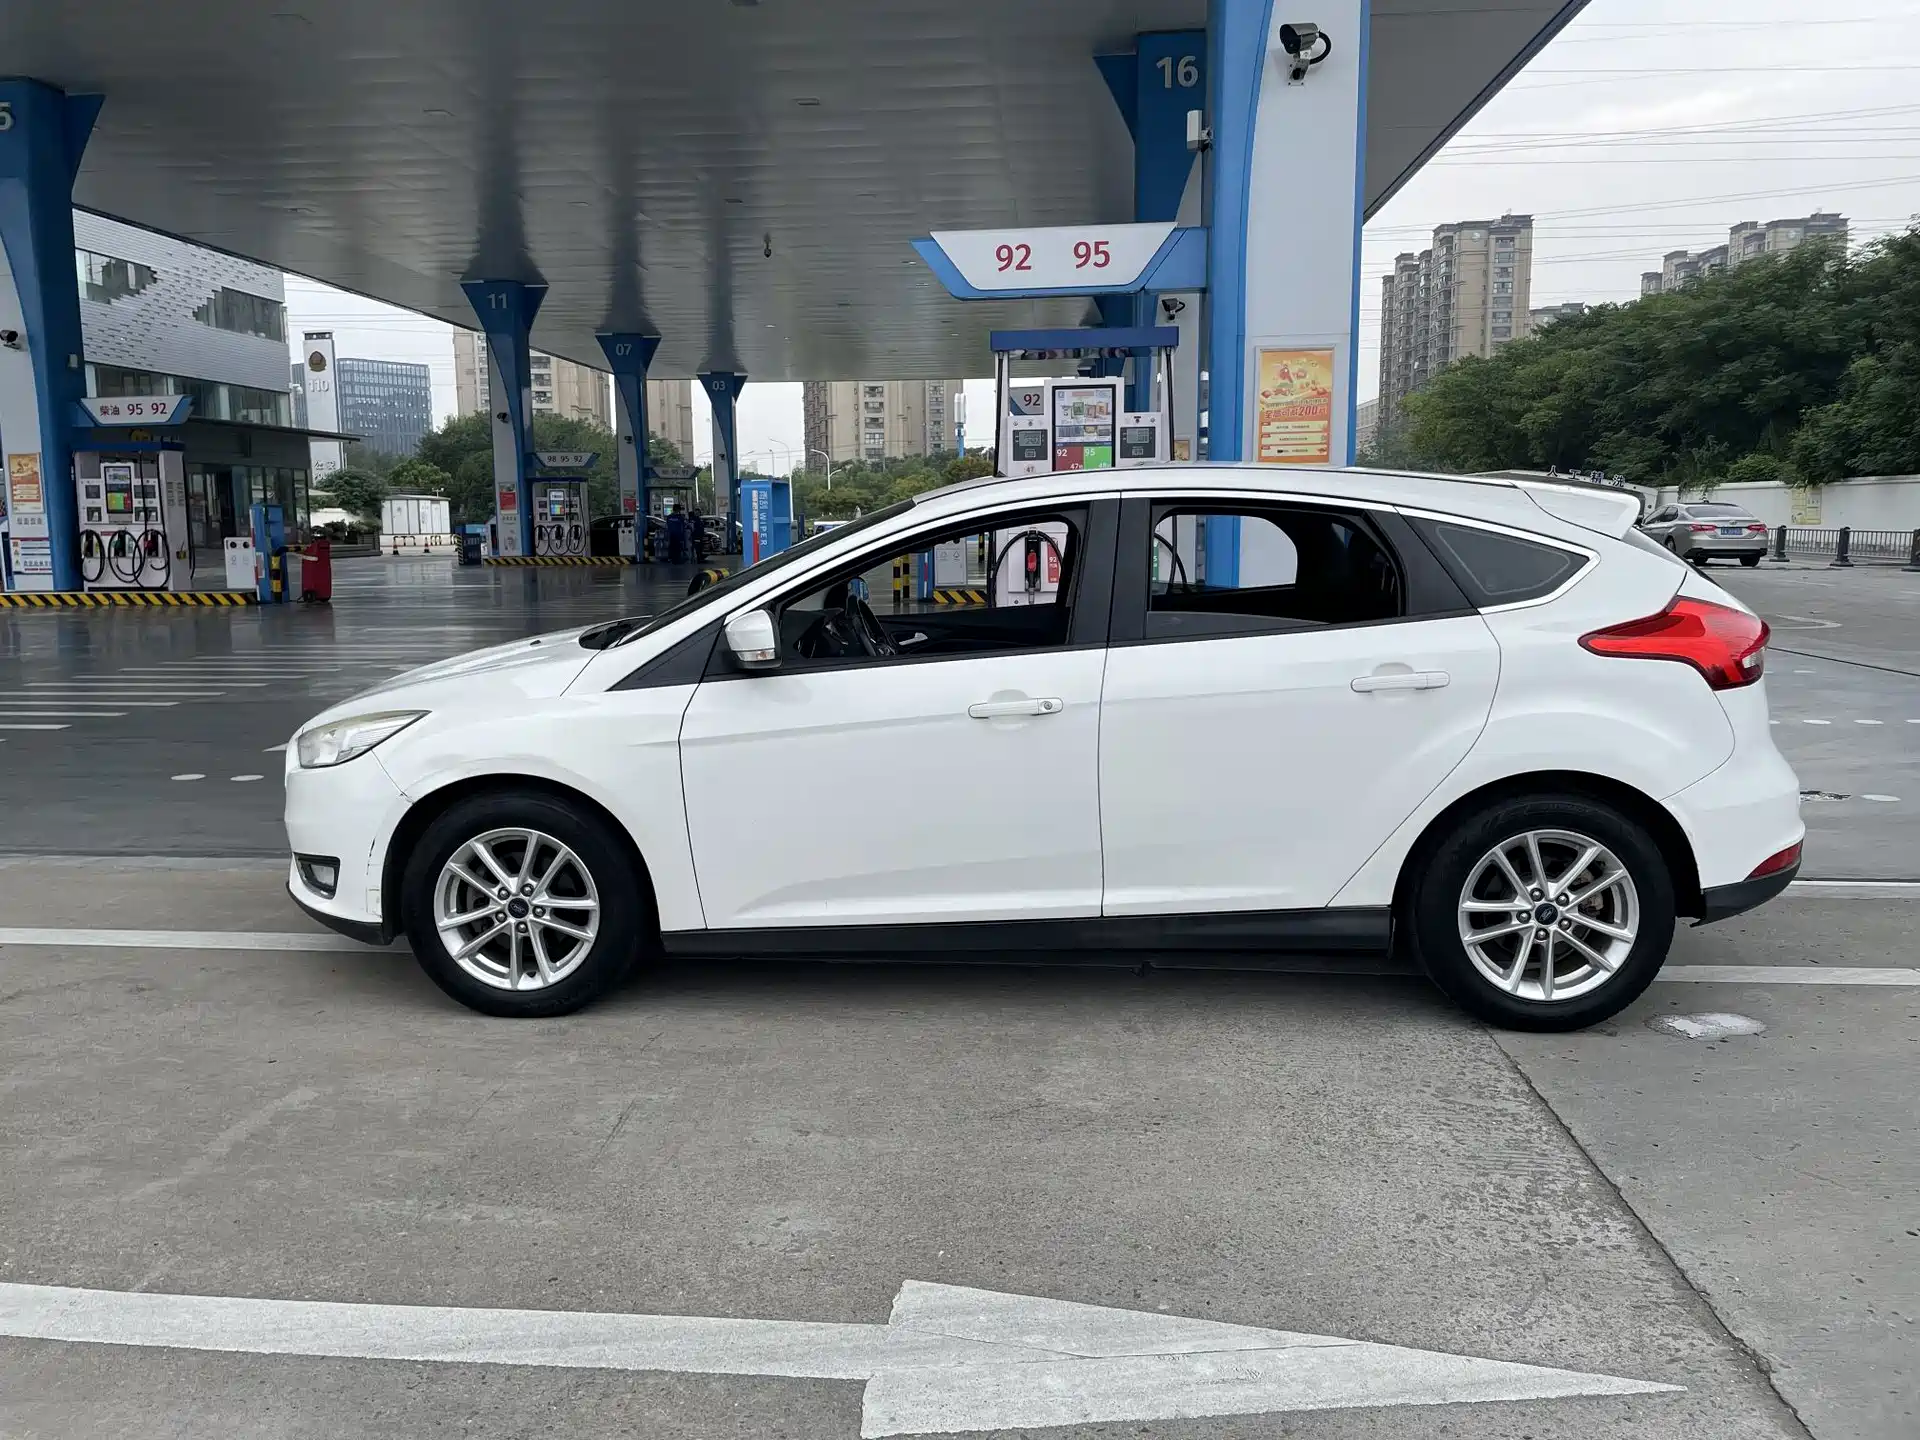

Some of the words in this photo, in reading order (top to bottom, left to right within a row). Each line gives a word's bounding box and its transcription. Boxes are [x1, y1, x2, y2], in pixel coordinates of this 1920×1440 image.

[1156, 55, 1199, 89] 16
[995, 243, 1032, 272] 92
[1073, 240, 1110, 269] 95
[487, 293, 508, 309] 11
[615, 343, 632, 356] 07
[308, 379, 330, 393] 110
[712, 380, 726, 391] 03
[1023, 393, 1041, 407] 92
[99, 404, 120, 416] 柴油
[127, 403, 143, 416] 95
[151, 402, 167, 415] 92
[560, 455, 570, 463] 95
[573, 455, 583, 463] 92
[1056, 448, 1068, 457] 92
[1084, 448, 1096, 457] 95
[1546, 464, 1625, 488] 人工精洗
[759, 512, 768, 546] WIPER
